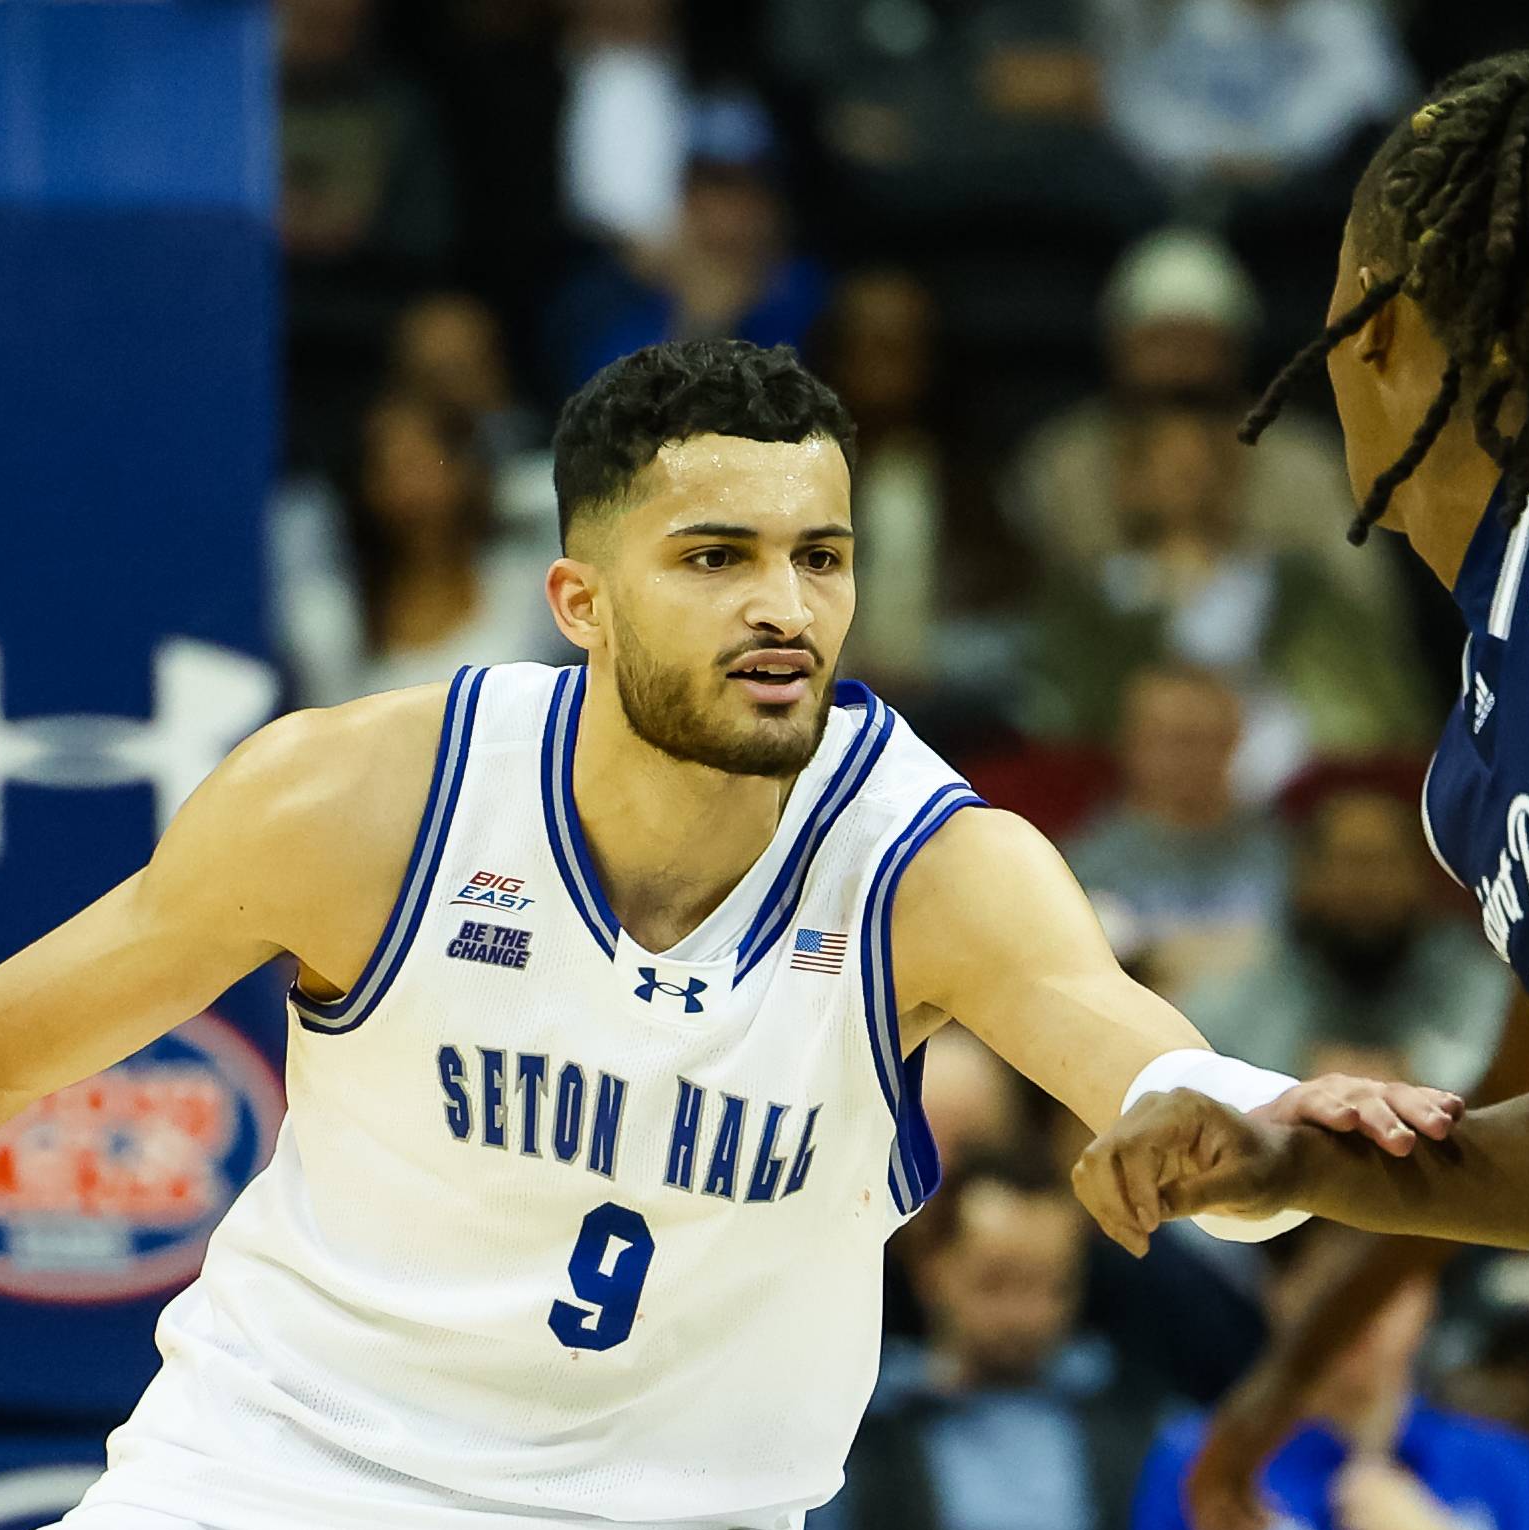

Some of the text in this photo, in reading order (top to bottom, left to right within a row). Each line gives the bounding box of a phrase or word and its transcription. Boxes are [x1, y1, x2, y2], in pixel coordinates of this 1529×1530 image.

[468, 870, 526, 893] BIG
[457, 885, 535, 911] EAST
[459, 920, 532, 949] BE THE
[447, 939, 532, 969] CHANGE
[436, 1044, 824, 1204] SETON HALL
[547, 1201, 656, 1352] 9
